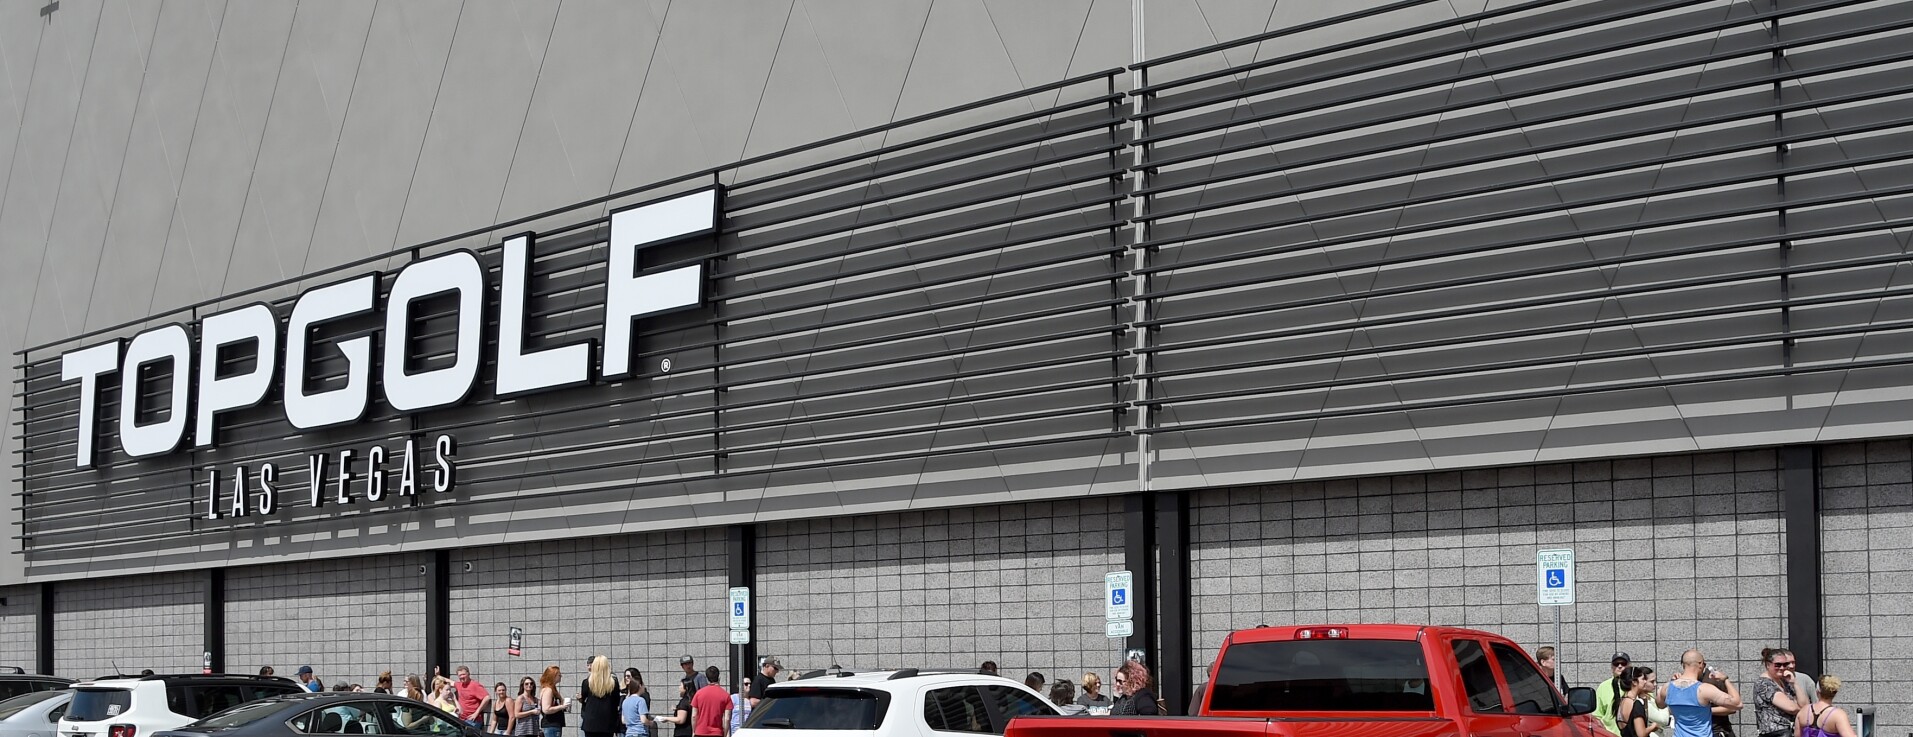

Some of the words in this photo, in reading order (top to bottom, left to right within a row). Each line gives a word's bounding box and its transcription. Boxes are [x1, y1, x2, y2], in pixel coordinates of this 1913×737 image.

[61, 187, 718, 469] TOPGOLF
[208, 462, 273, 519] LAS
[309, 434, 452, 507] VEGAS
